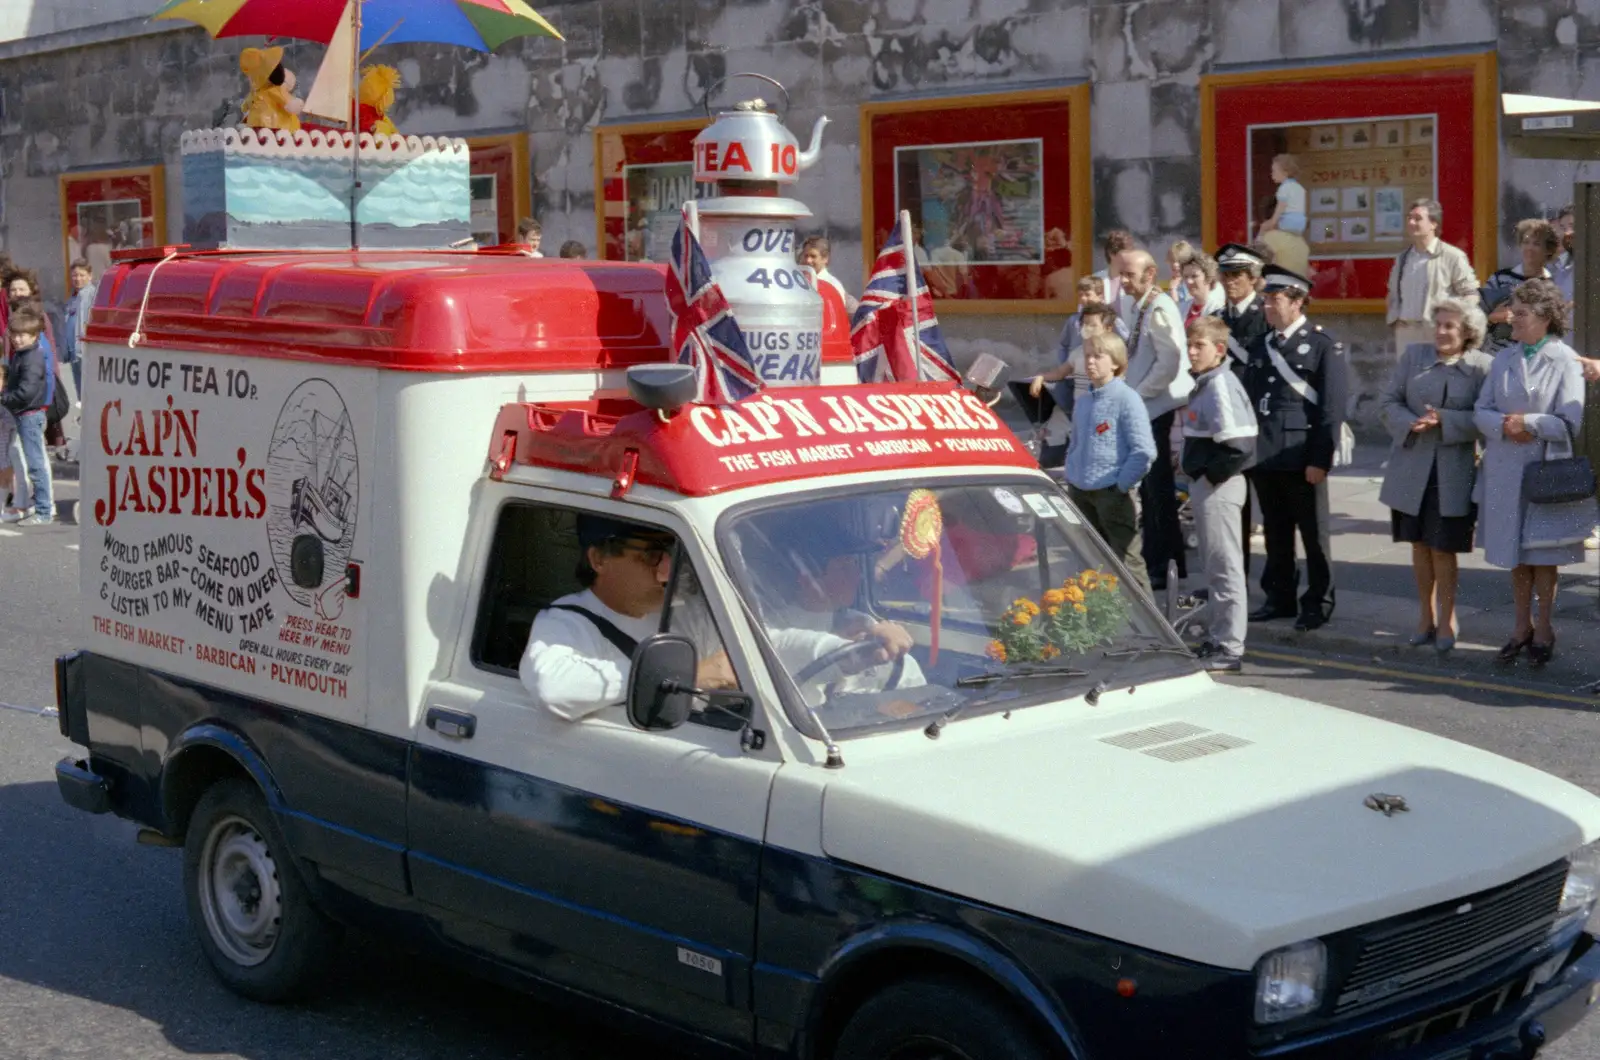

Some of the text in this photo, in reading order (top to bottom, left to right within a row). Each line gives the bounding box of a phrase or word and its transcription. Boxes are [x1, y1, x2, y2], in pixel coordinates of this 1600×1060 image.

[696, 142, 752, 172] TEA
[743, 228, 795, 253] OVE
[743, 331, 790, 351] UGS
[98, 356, 140, 385] MUG
[147, 361, 171, 389] OF
[180, 364, 219, 396] TEA
[690, 391, 999, 448] CAP'N JASPER'S
[95, 394, 266, 527] CAP'N JASPER'S
[719, 437, 1015, 473] THE FISH MARKET BARBICAN PLYMOUTH
[104, 530, 260, 579] WORLD FAMOUS SEAFOOD
[100, 555, 110, 572] &
[111, 563, 152, 591] BURGER
[228, 586, 244, 607] ON
[247, 567, 278, 599] OVER
[100, 582, 275, 635] & LISTEN TO MY MENU TAPE
[286, 615, 352, 641] PRESS HEAR TO
[93, 615, 347, 699] THE FISH MARKET BARBICAN PLYMOUTH
[239, 639, 352, 677] OPEN ALL HOURS EVERY DAY
[279, 628, 351, 655] HERE MY MENU
